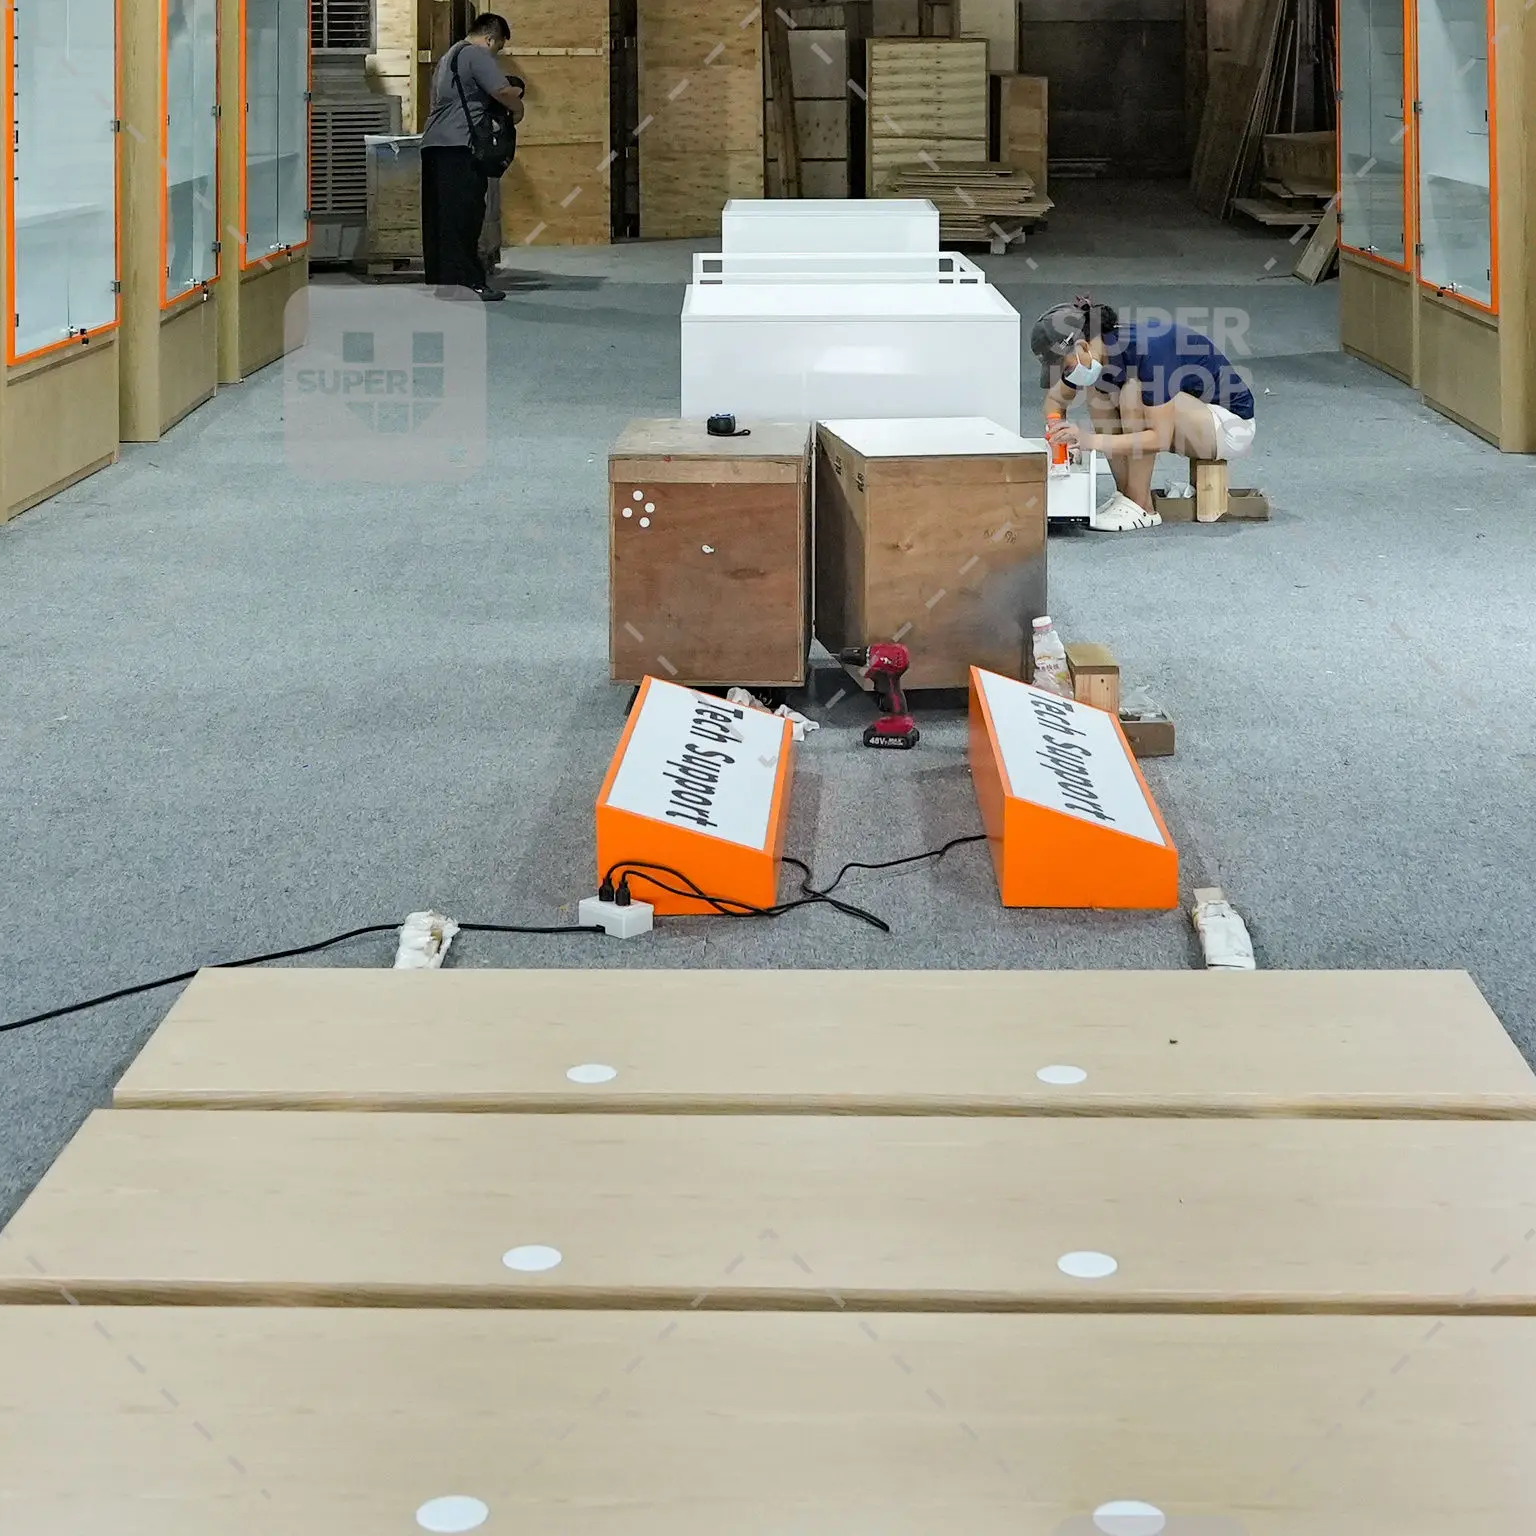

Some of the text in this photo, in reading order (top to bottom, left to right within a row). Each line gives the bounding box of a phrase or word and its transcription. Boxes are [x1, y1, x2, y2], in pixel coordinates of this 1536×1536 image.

[662, 700, 744, 827] Tech Support
[1027, 692, 1116, 822] Tech Support
